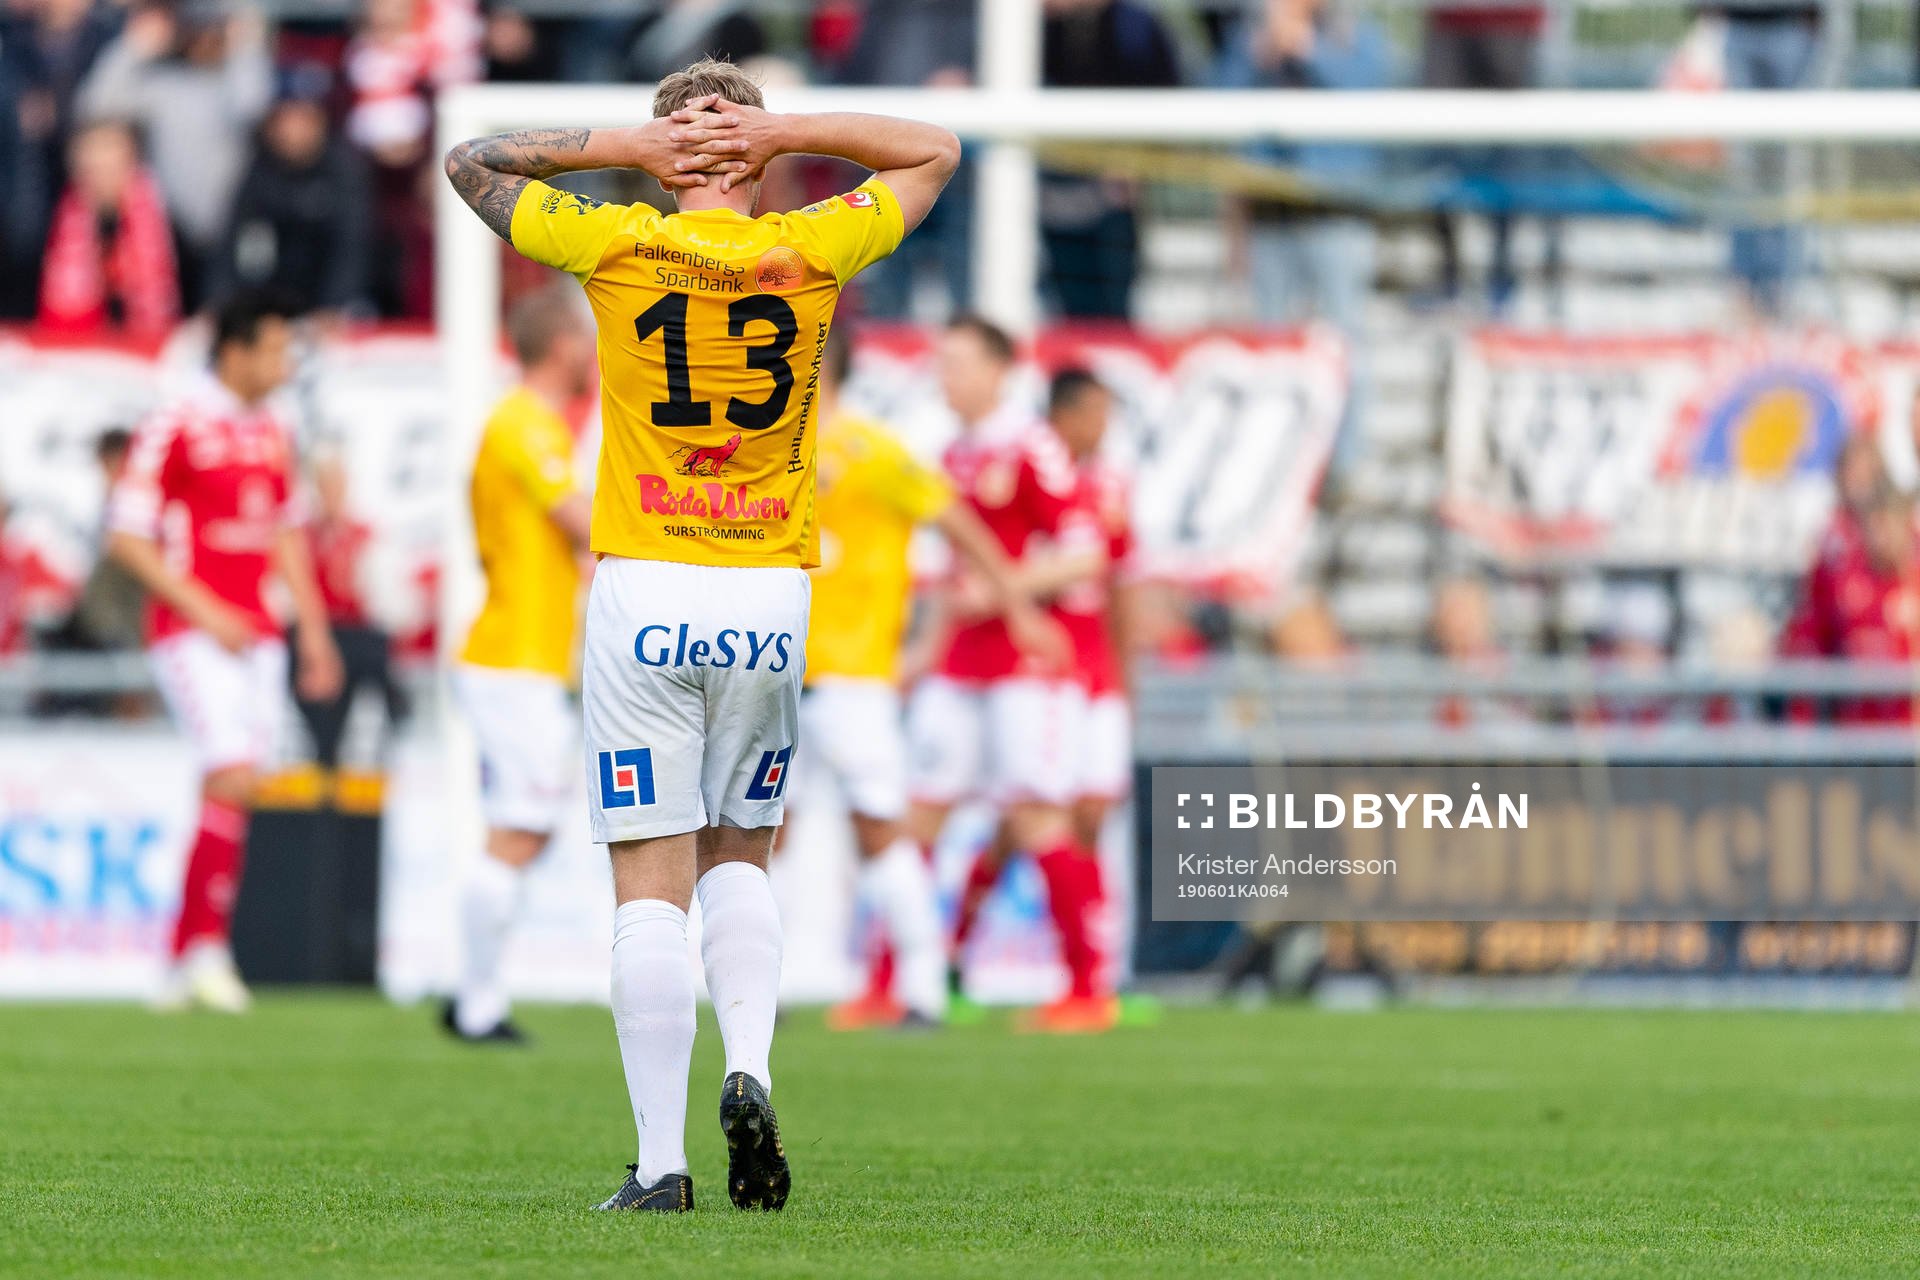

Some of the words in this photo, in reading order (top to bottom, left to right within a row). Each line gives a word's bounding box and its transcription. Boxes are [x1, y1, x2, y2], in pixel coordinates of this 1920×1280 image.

[634, 242, 745, 277] Falkenbergs
[655, 266, 745, 293] Sparbank
[634, 292, 798, 430] 13
[787, 392, 814, 475] Hallands
[806, 321, 827, 390] Nyheter
[635, 473, 708, 518] Röda
[702, 482, 790, 521] Ulven
[663, 524, 766, 541] SURSTRÖMMING
[633, 623, 793, 673] GleSYS
